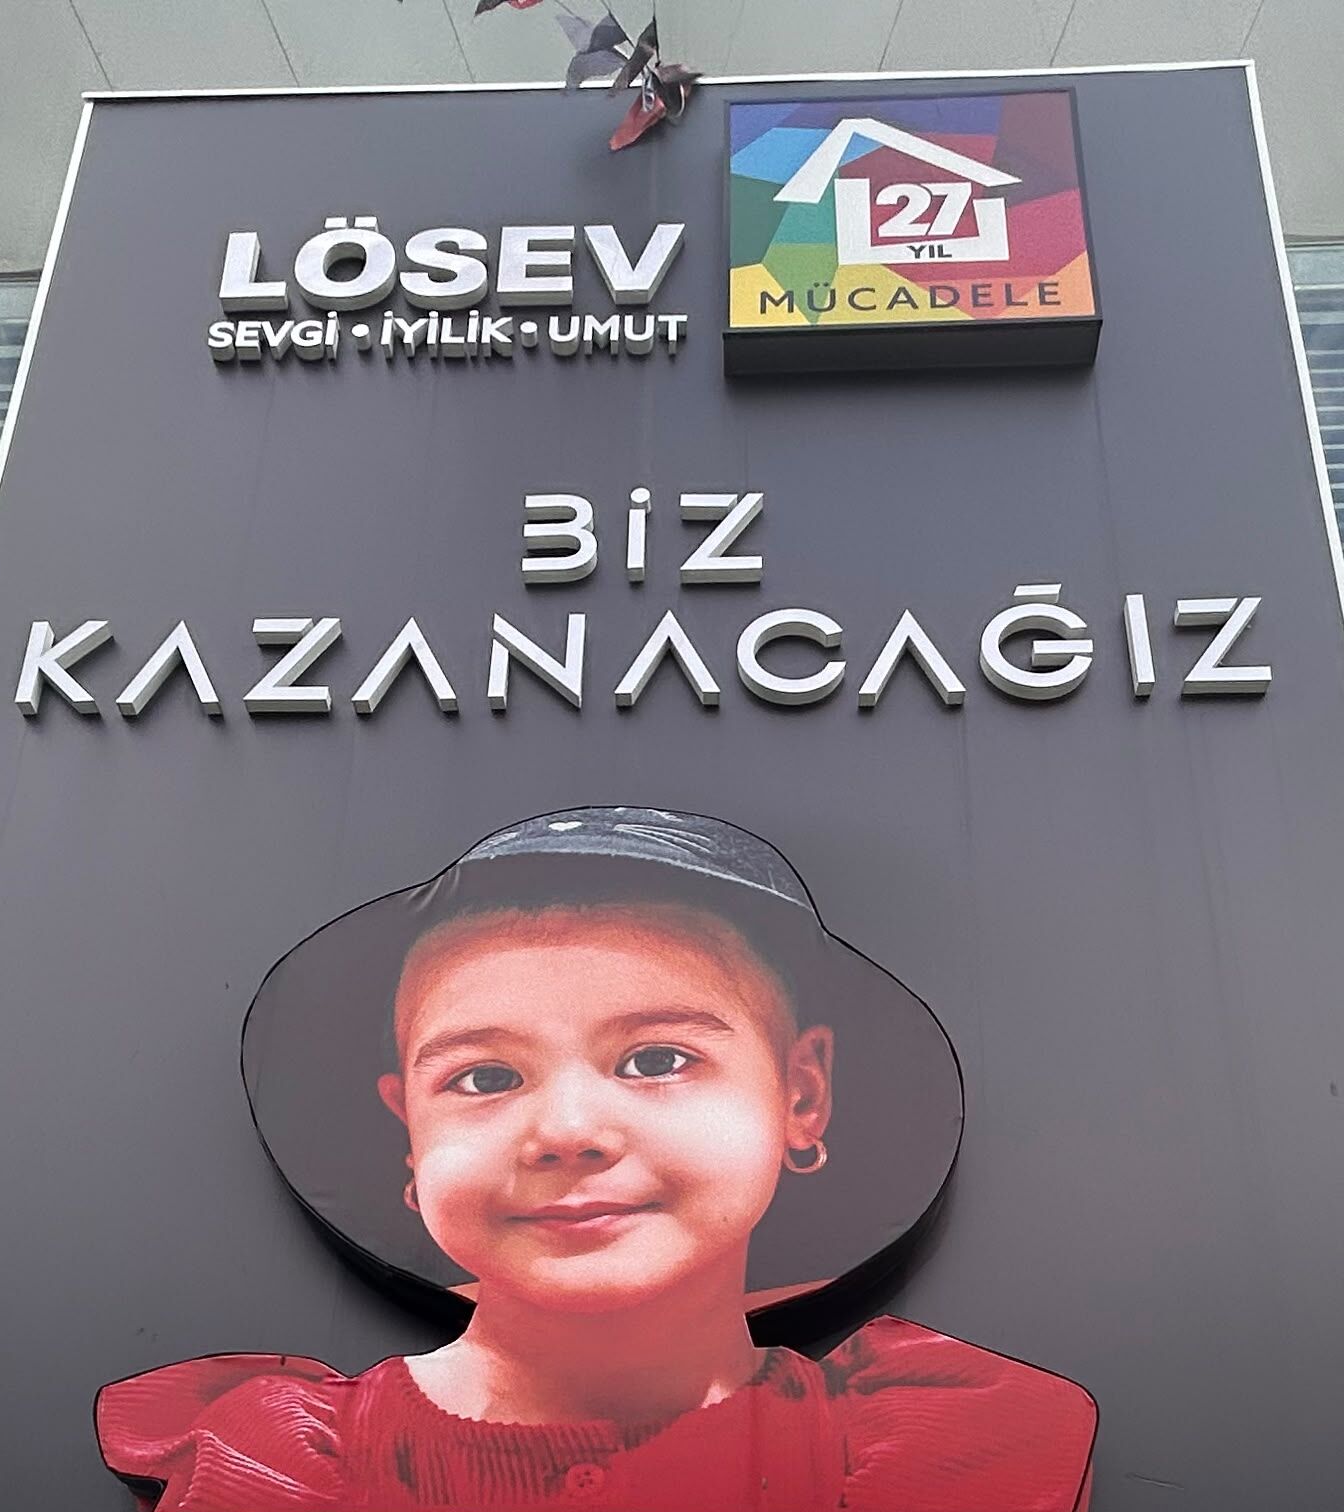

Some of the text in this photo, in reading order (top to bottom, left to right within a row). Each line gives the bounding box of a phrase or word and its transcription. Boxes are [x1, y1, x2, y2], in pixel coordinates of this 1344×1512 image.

[875, 182, 973, 239] 27
[219, 216, 685, 311] LÖSEV
[905, 243, 953, 260] YIL
[759, 281, 1062, 315] MÜCADELE
[208, 310, 688, 360] SEVGİ İYİLİK UMUT
[14, 583, 1273, 715] KAZANACAĞIZ
